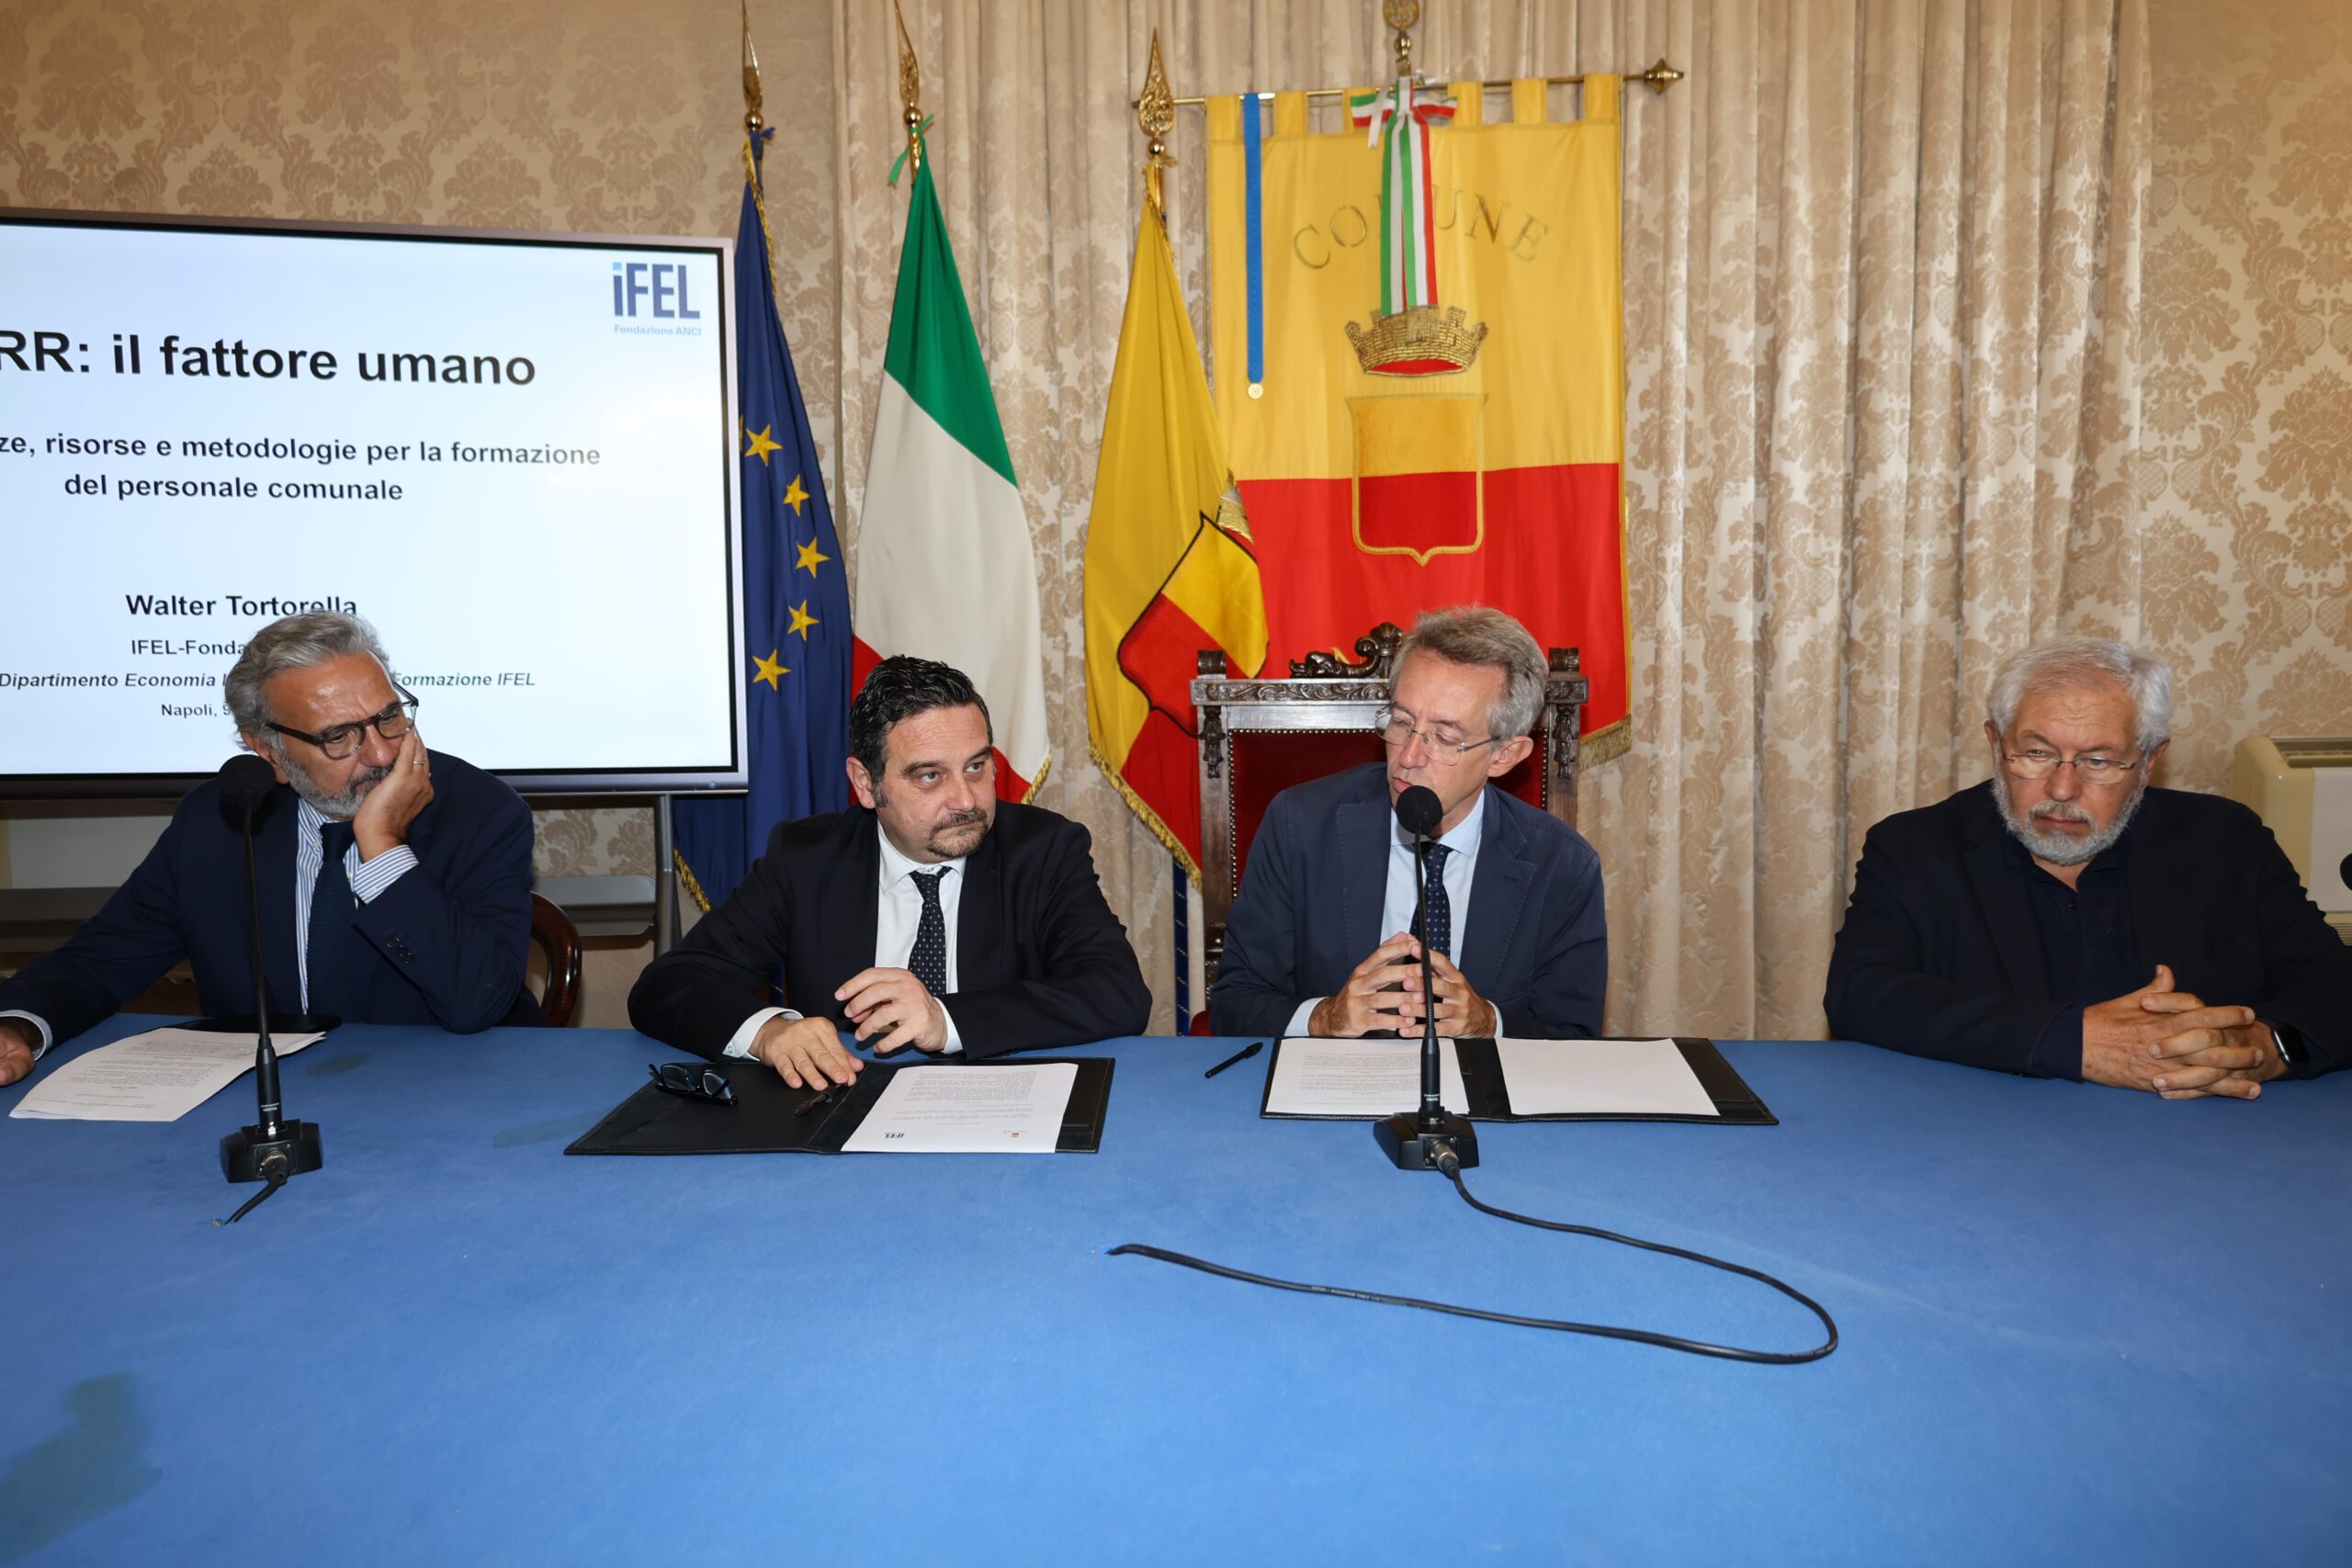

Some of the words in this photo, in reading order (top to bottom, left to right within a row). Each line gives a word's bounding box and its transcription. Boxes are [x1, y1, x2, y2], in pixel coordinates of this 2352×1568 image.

[1294, 184, 1549, 269] COUNE
[614, 324, 673, 336] Fondazione
[675, 326, 702, 336] ANCI
[113, 333, 141, 375] il
[160, 334, 338, 379] fattore
[358, 352, 536, 386] umano
[46, 433, 147, 457] risorse
[156, 440, 172, 457] e
[182, 437, 356, 466] metodologie
[368, 445, 411, 466] per
[420, 441, 442, 462] la
[451, 442, 601, 465] formazione
[64, 474, 107, 495] del
[118, 477, 258, 501] personale
[267, 479, 403, 501] comunale
[126, 594, 216, 616] Walter
[226, 595, 356, 616] Tortorella
[0, 672, 119, 691] Dipartimento
[125, 672, 216, 687] Economia
[497, 672, 536, 686] IFEL
[161, 704, 218, 719] Napoli,
